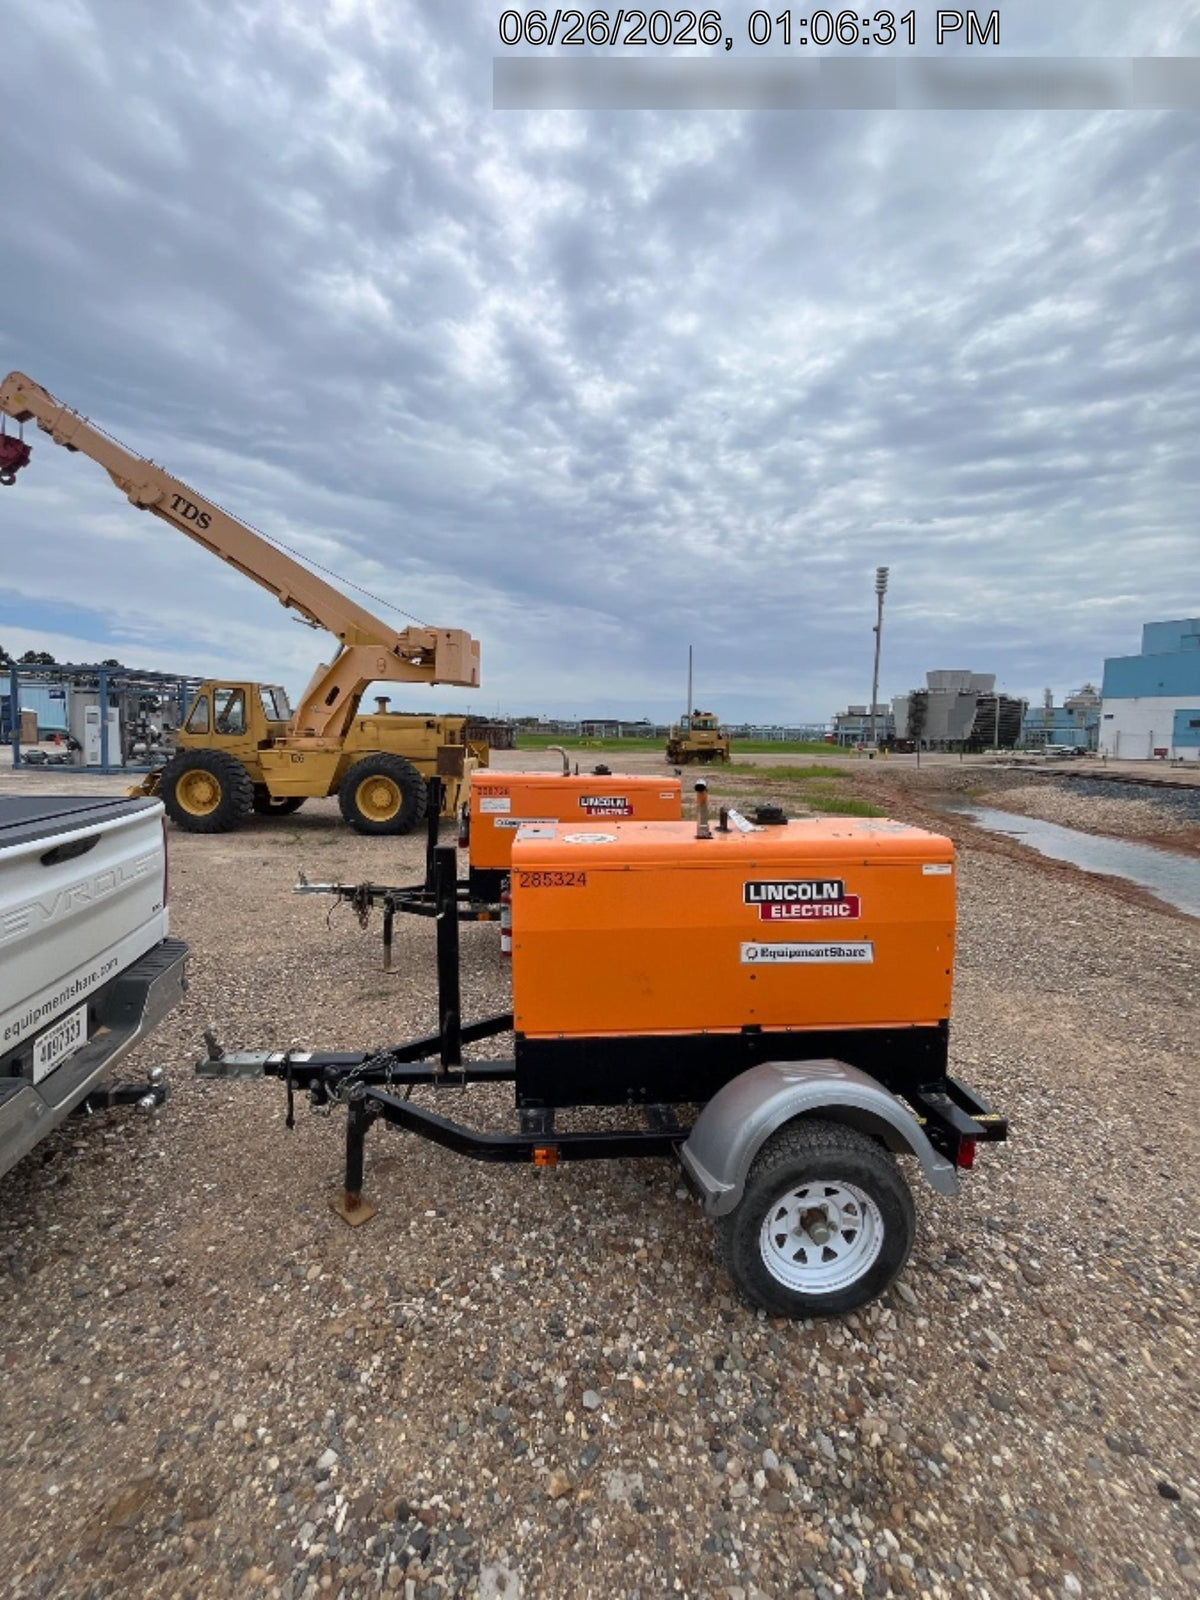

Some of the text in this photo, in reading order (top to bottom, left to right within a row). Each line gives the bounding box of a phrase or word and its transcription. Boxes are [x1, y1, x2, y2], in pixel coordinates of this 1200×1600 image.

[170, 493, 213, 530] TDS
[580, 797, 626, 808] LINCOLN
[520, 871, 587, 888] 285324
[749, 883, 839, 901] LINCOLN
[771, 903, 852, 919] ELECTRIC
[760, 946, 867, 960] EquipmentShare
[4, 957, 119, 1041] equipmentshare.com
